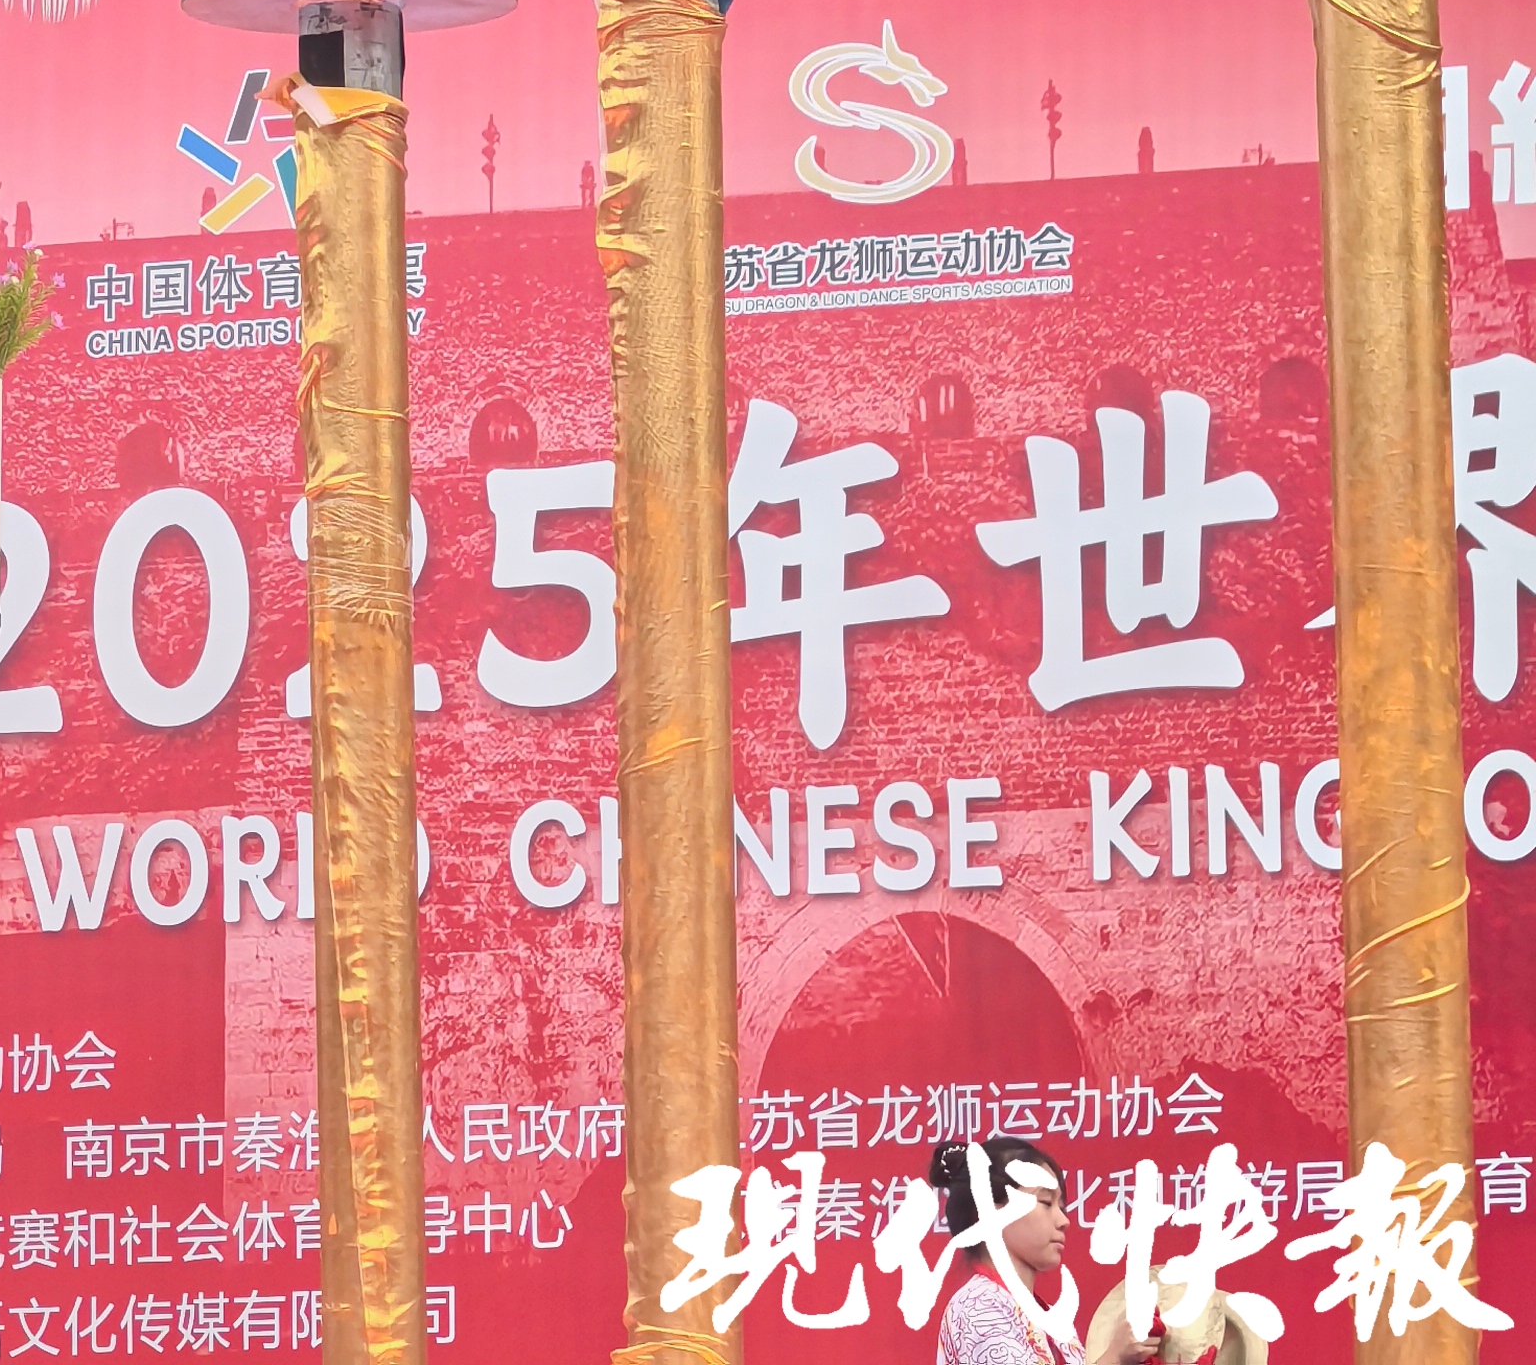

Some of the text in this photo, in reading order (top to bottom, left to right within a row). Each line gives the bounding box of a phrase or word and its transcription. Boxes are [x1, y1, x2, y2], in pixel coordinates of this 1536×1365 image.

[745, 296, 806, 313] DRAGON
[809, 295, 820, 308] &
[823, 292, 856, 307] LION
[859, 288, 909, 305] DANCE
[912, 284, 971, 301] SPORTS
[973, 276, 1071, 297] ASSOCIATION
[87, 329, 171, 358] CHINA
[178, 318, 291, 352] SPORTS
[509, 776, 1004, 910] CNESE
[64, 1097, 625, 1179] 南京市秦淮人民政府
[739, 1072, 1224, 1153] 苏省龙狮运动协会
